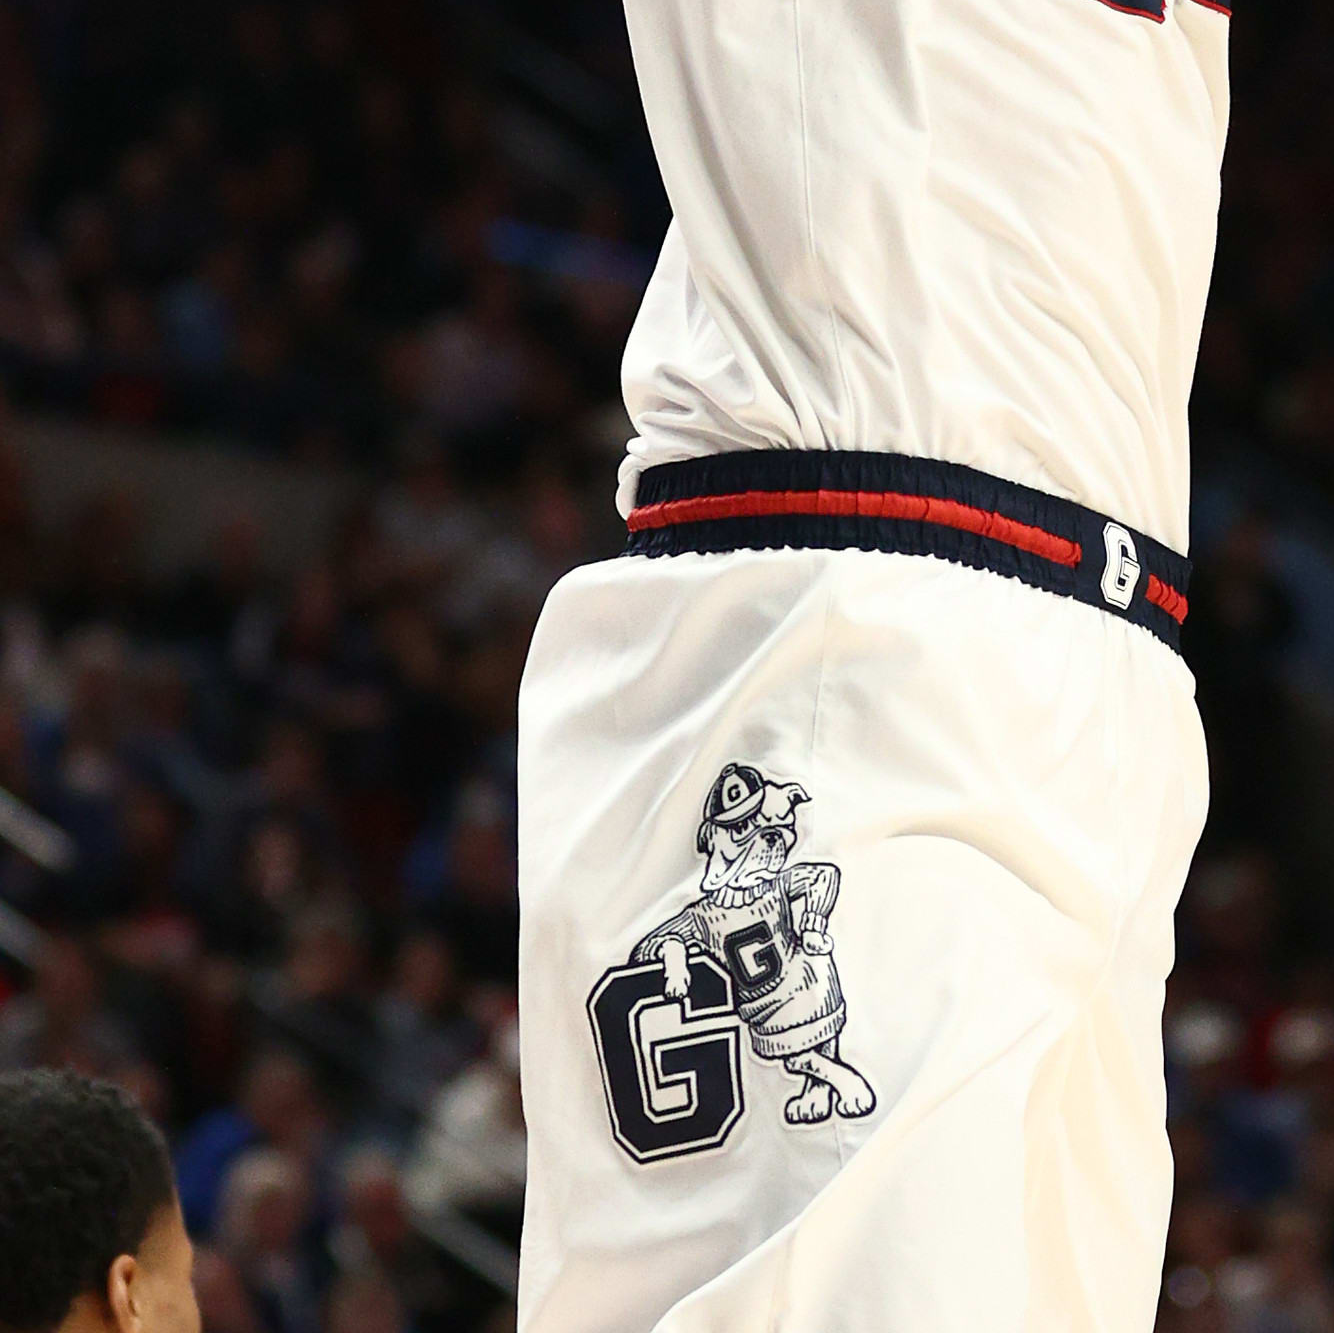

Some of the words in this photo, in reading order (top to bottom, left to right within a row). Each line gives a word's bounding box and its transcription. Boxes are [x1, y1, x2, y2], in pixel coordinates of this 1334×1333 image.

[1101, 521, 1141, 610] G
[727, 784, 741, 802] G
[724, 920, 783, 991] G
[586, 954, 745, 1165] G
